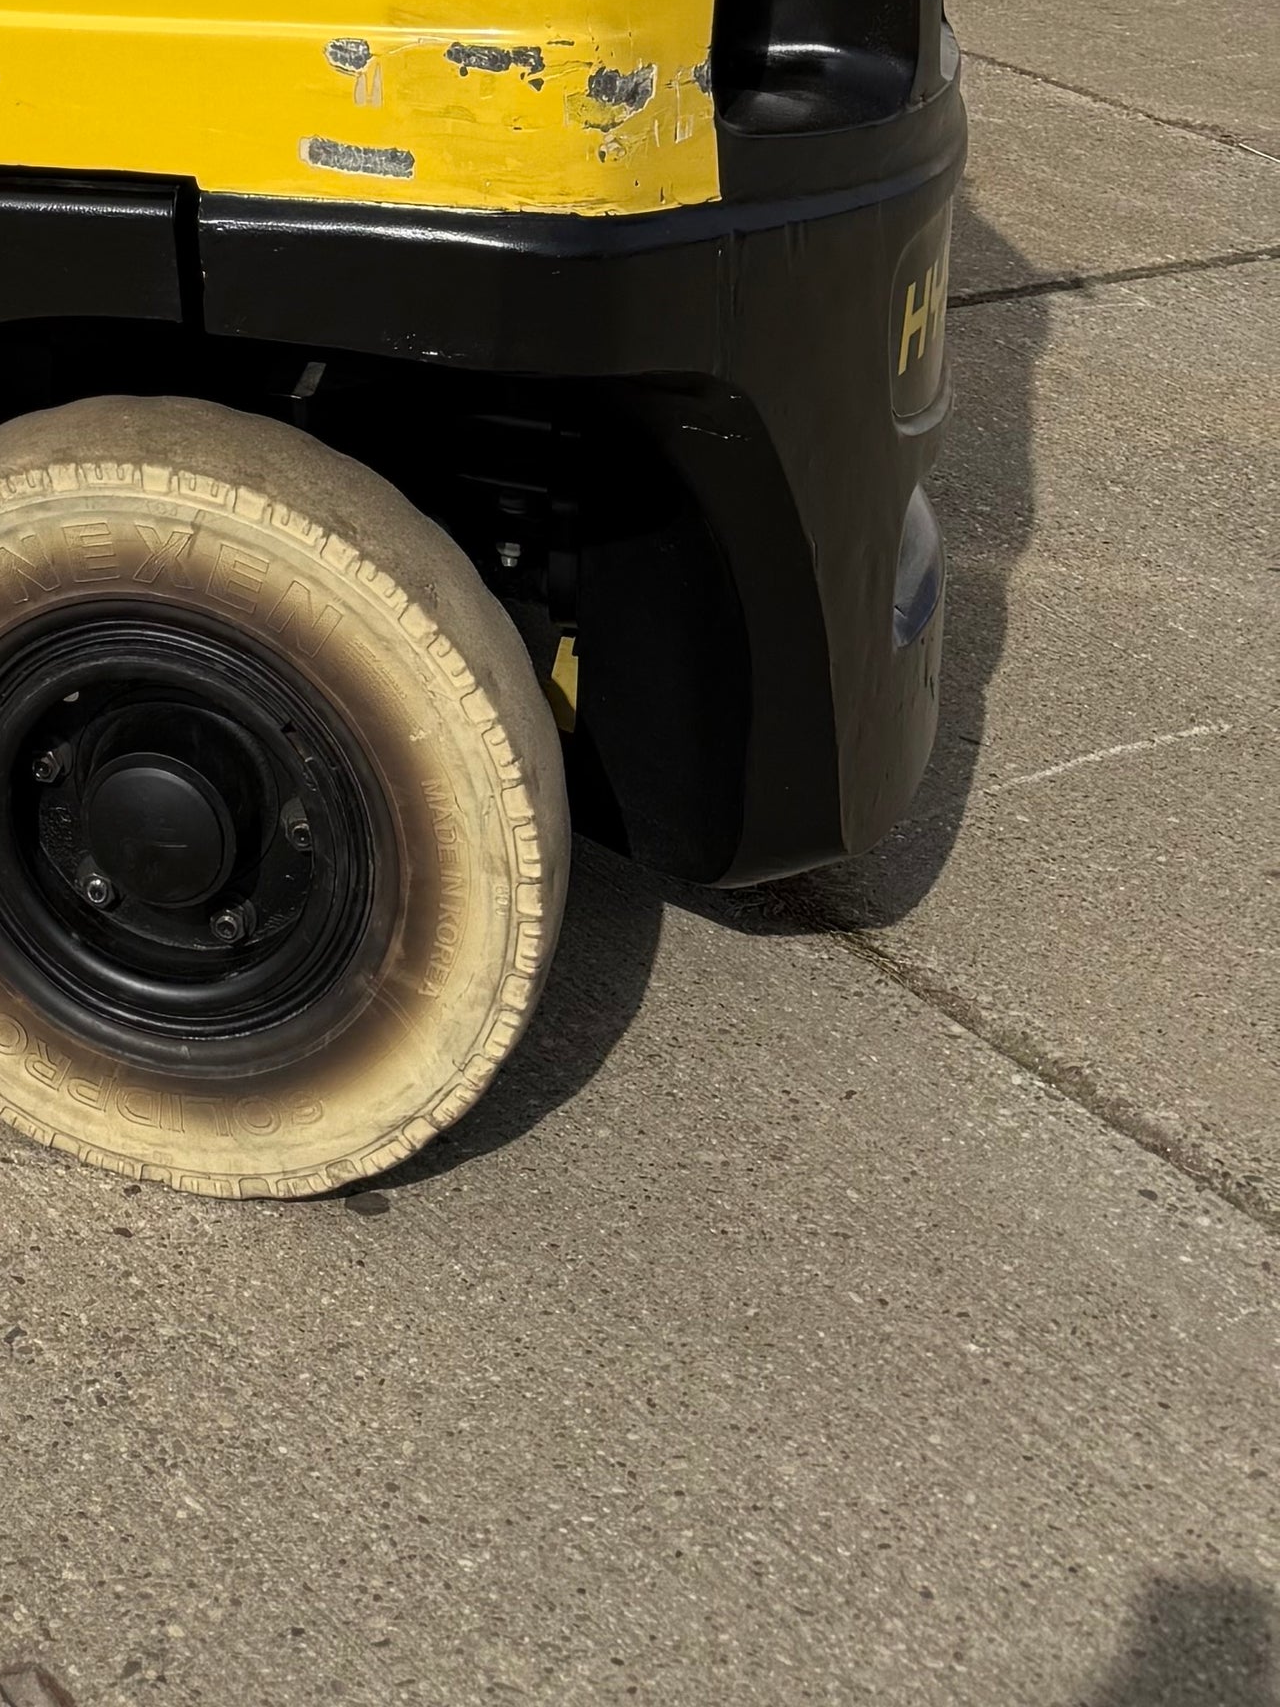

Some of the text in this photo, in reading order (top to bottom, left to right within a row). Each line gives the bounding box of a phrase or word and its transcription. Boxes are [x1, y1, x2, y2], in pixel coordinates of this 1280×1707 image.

[418, 778, 468, 999] MADE IN KOREA
